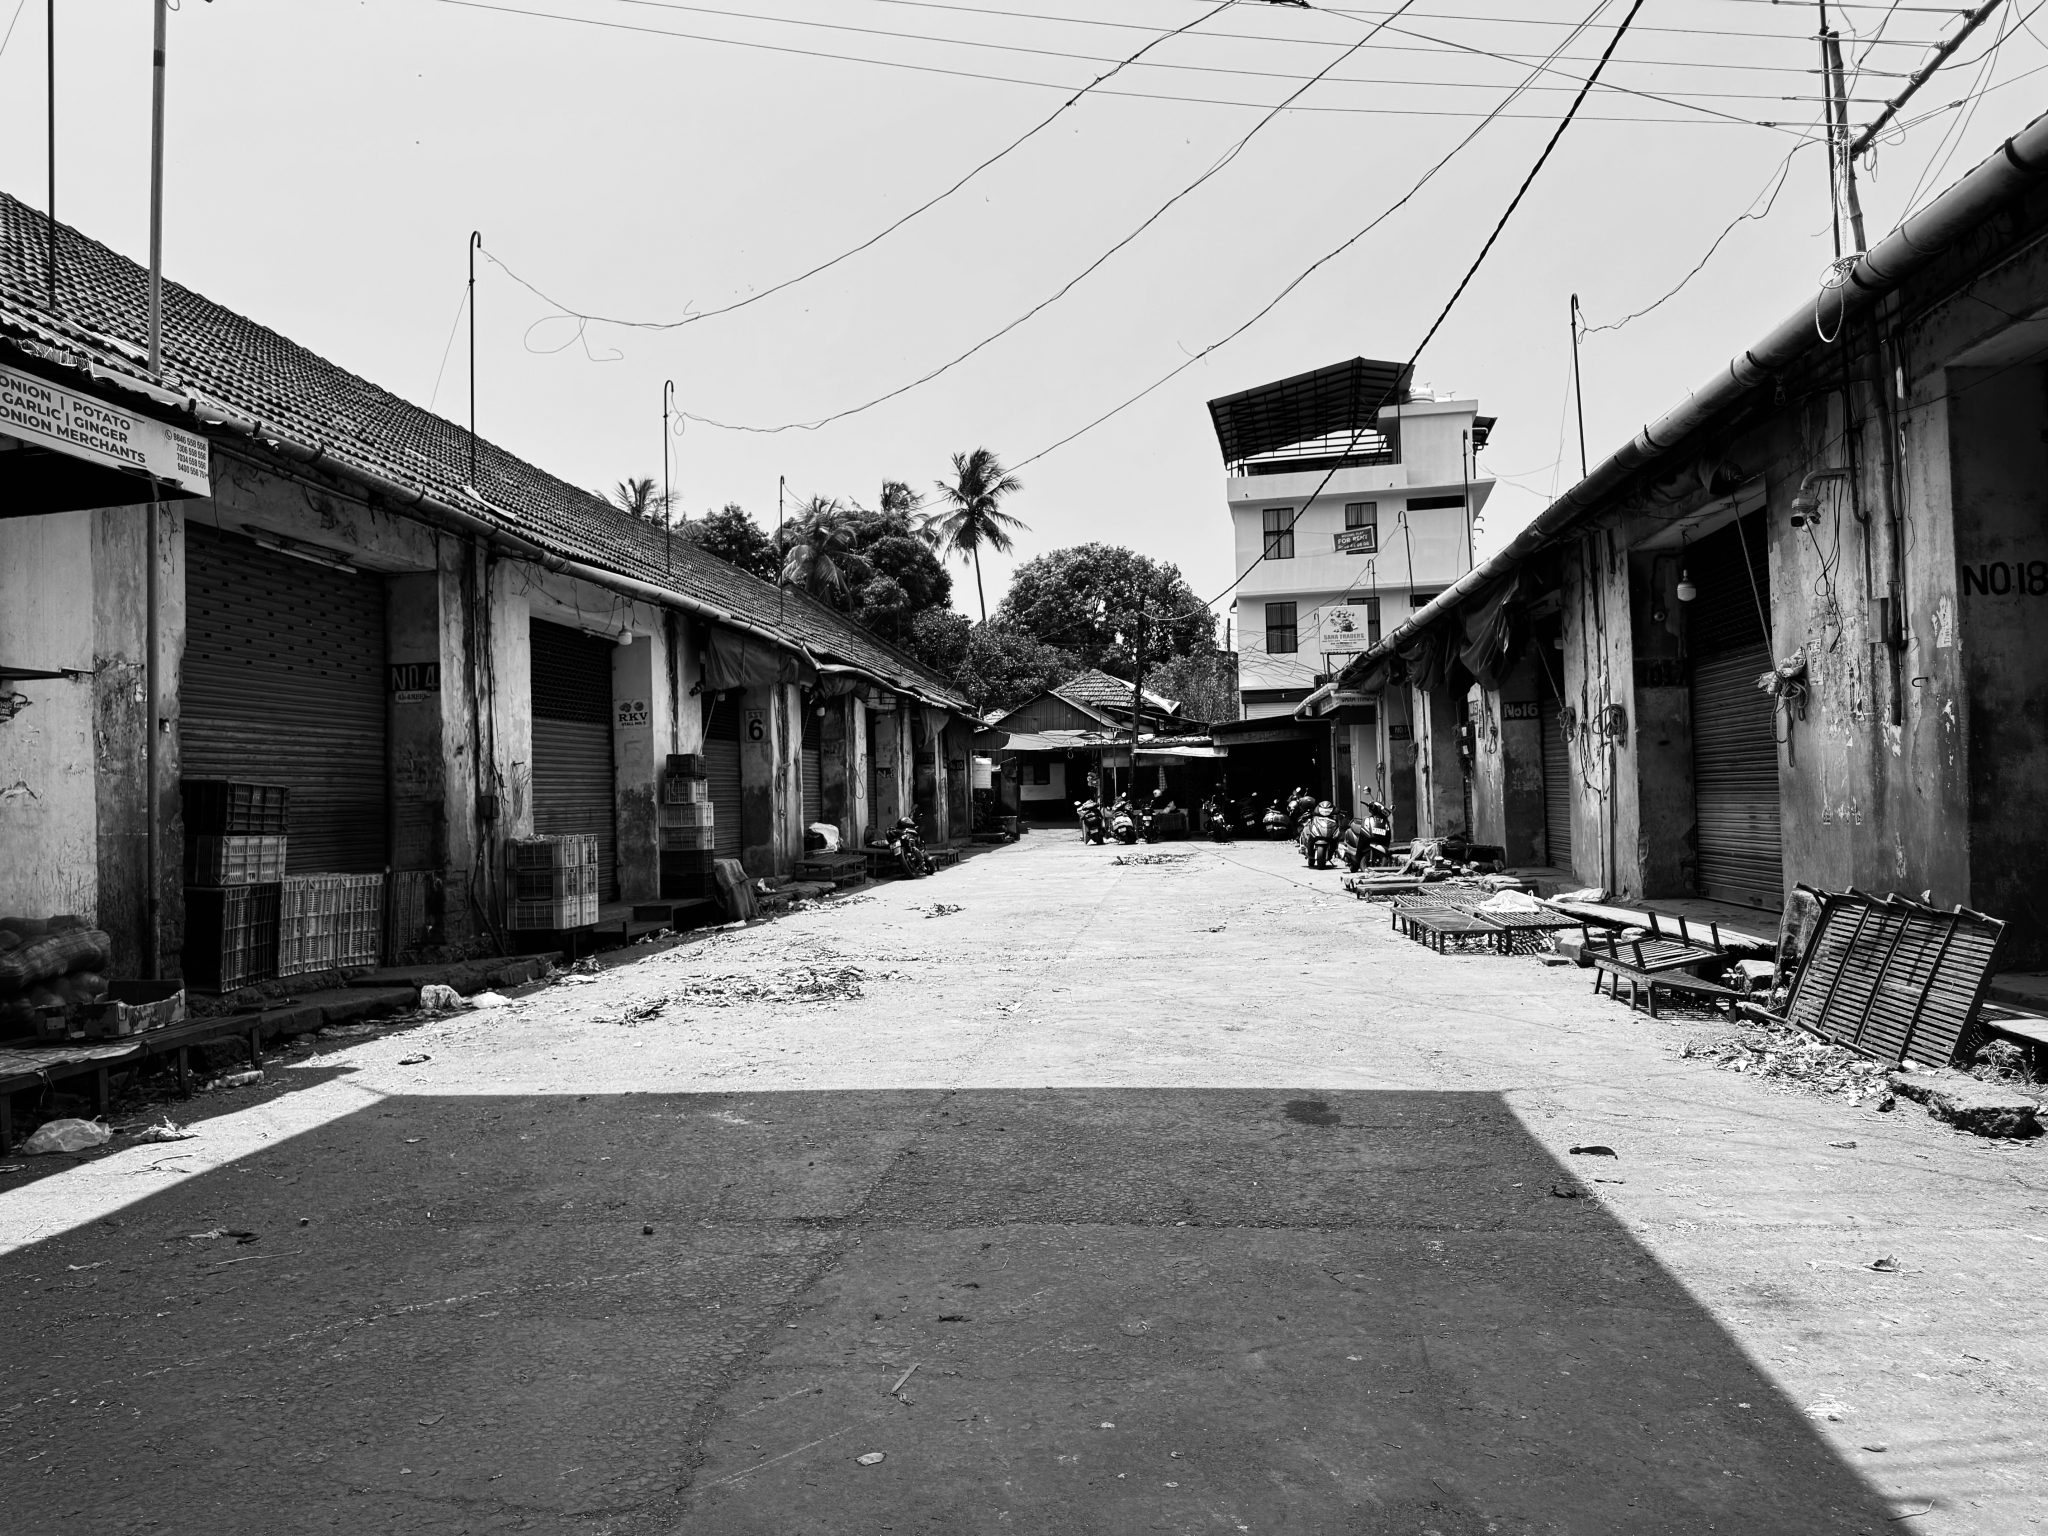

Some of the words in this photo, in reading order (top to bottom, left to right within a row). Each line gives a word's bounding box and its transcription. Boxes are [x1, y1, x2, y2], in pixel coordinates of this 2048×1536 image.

[0, 375, 52, 403] ONION
[73, 401, 131, 430] POTATO
[2, 392, 61, 420] GARLIC
[74, 416, 128, 443] GINGER
[0, 405, 52, 432] ONION
[56, 424, 146, 463] MERCHANTS
[424, 664, 440, 690] 4
[618, 711, 648, 722] RKV
[1503, 702, 1539, 718] No16
[748, 718, 764, 741] 6
